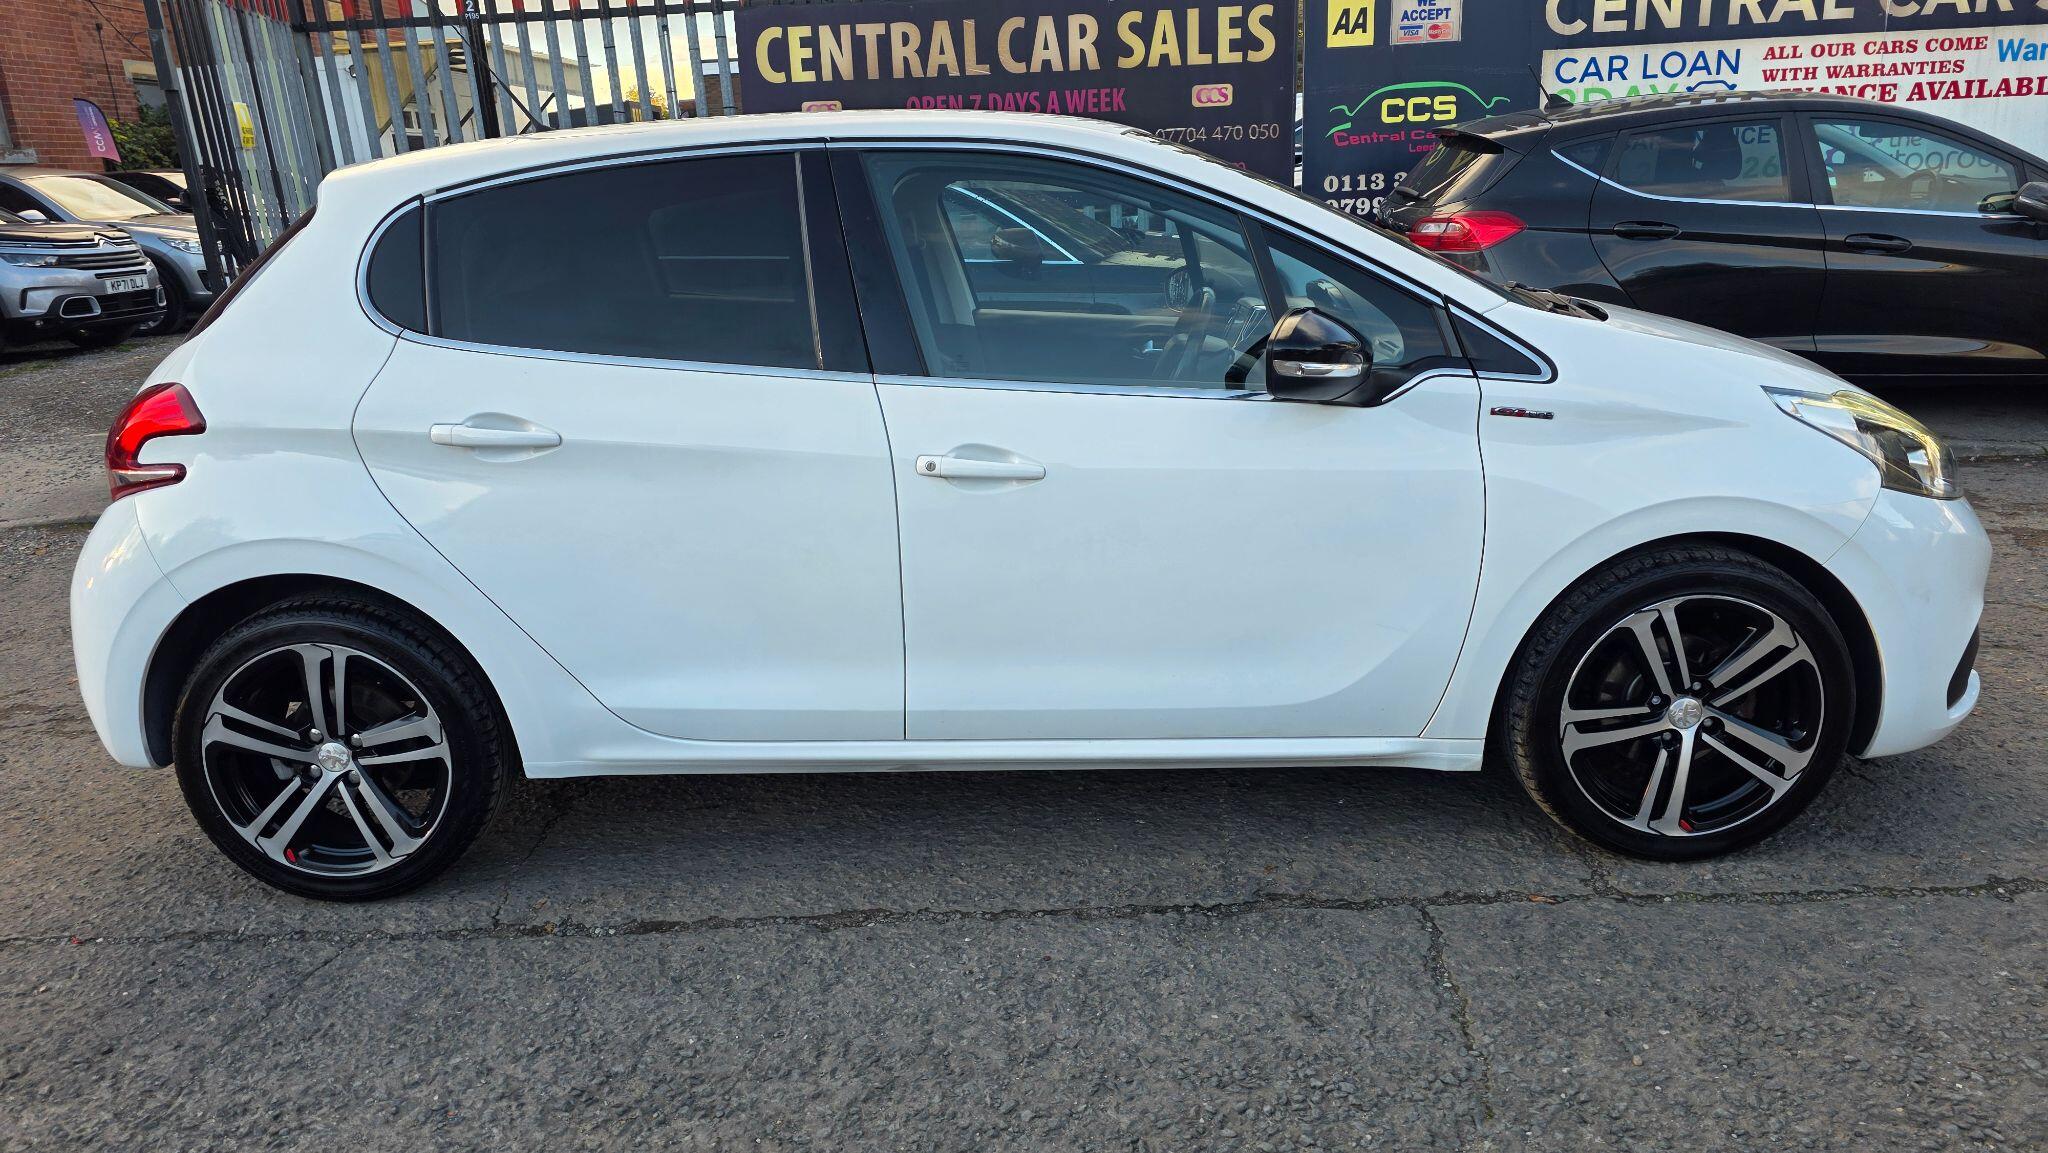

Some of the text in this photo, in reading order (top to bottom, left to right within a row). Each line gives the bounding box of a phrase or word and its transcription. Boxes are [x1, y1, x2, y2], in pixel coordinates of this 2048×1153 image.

[1332, 7, 1368, 35] AA
[1400, 7, 1451, 22] ACCEPT
[755, 4, 1276, 84] CENTRAL CAR SALES
[1763, 36, 1989, 60] ALL OUR CARS COME
[1555, 48, 1741, 84] CAR LOAN
[1762, 59, 1965, 82] WITH WARRANTIES
[988, 91, 1041, 113] DAYS
[1046, 90, 1060, 114] A
[1065, 87, 1126, 113] WEEK
[1380, 95, 1457, 124] CCS
[1212, 125, 1243, 141] 470
[1249, 123, 1280, 140] 050
[1333, 131, 1405, 147] Central
[1409, 142, 1437, 153] Leed
[1323, 172, 1385, 193] 0113
